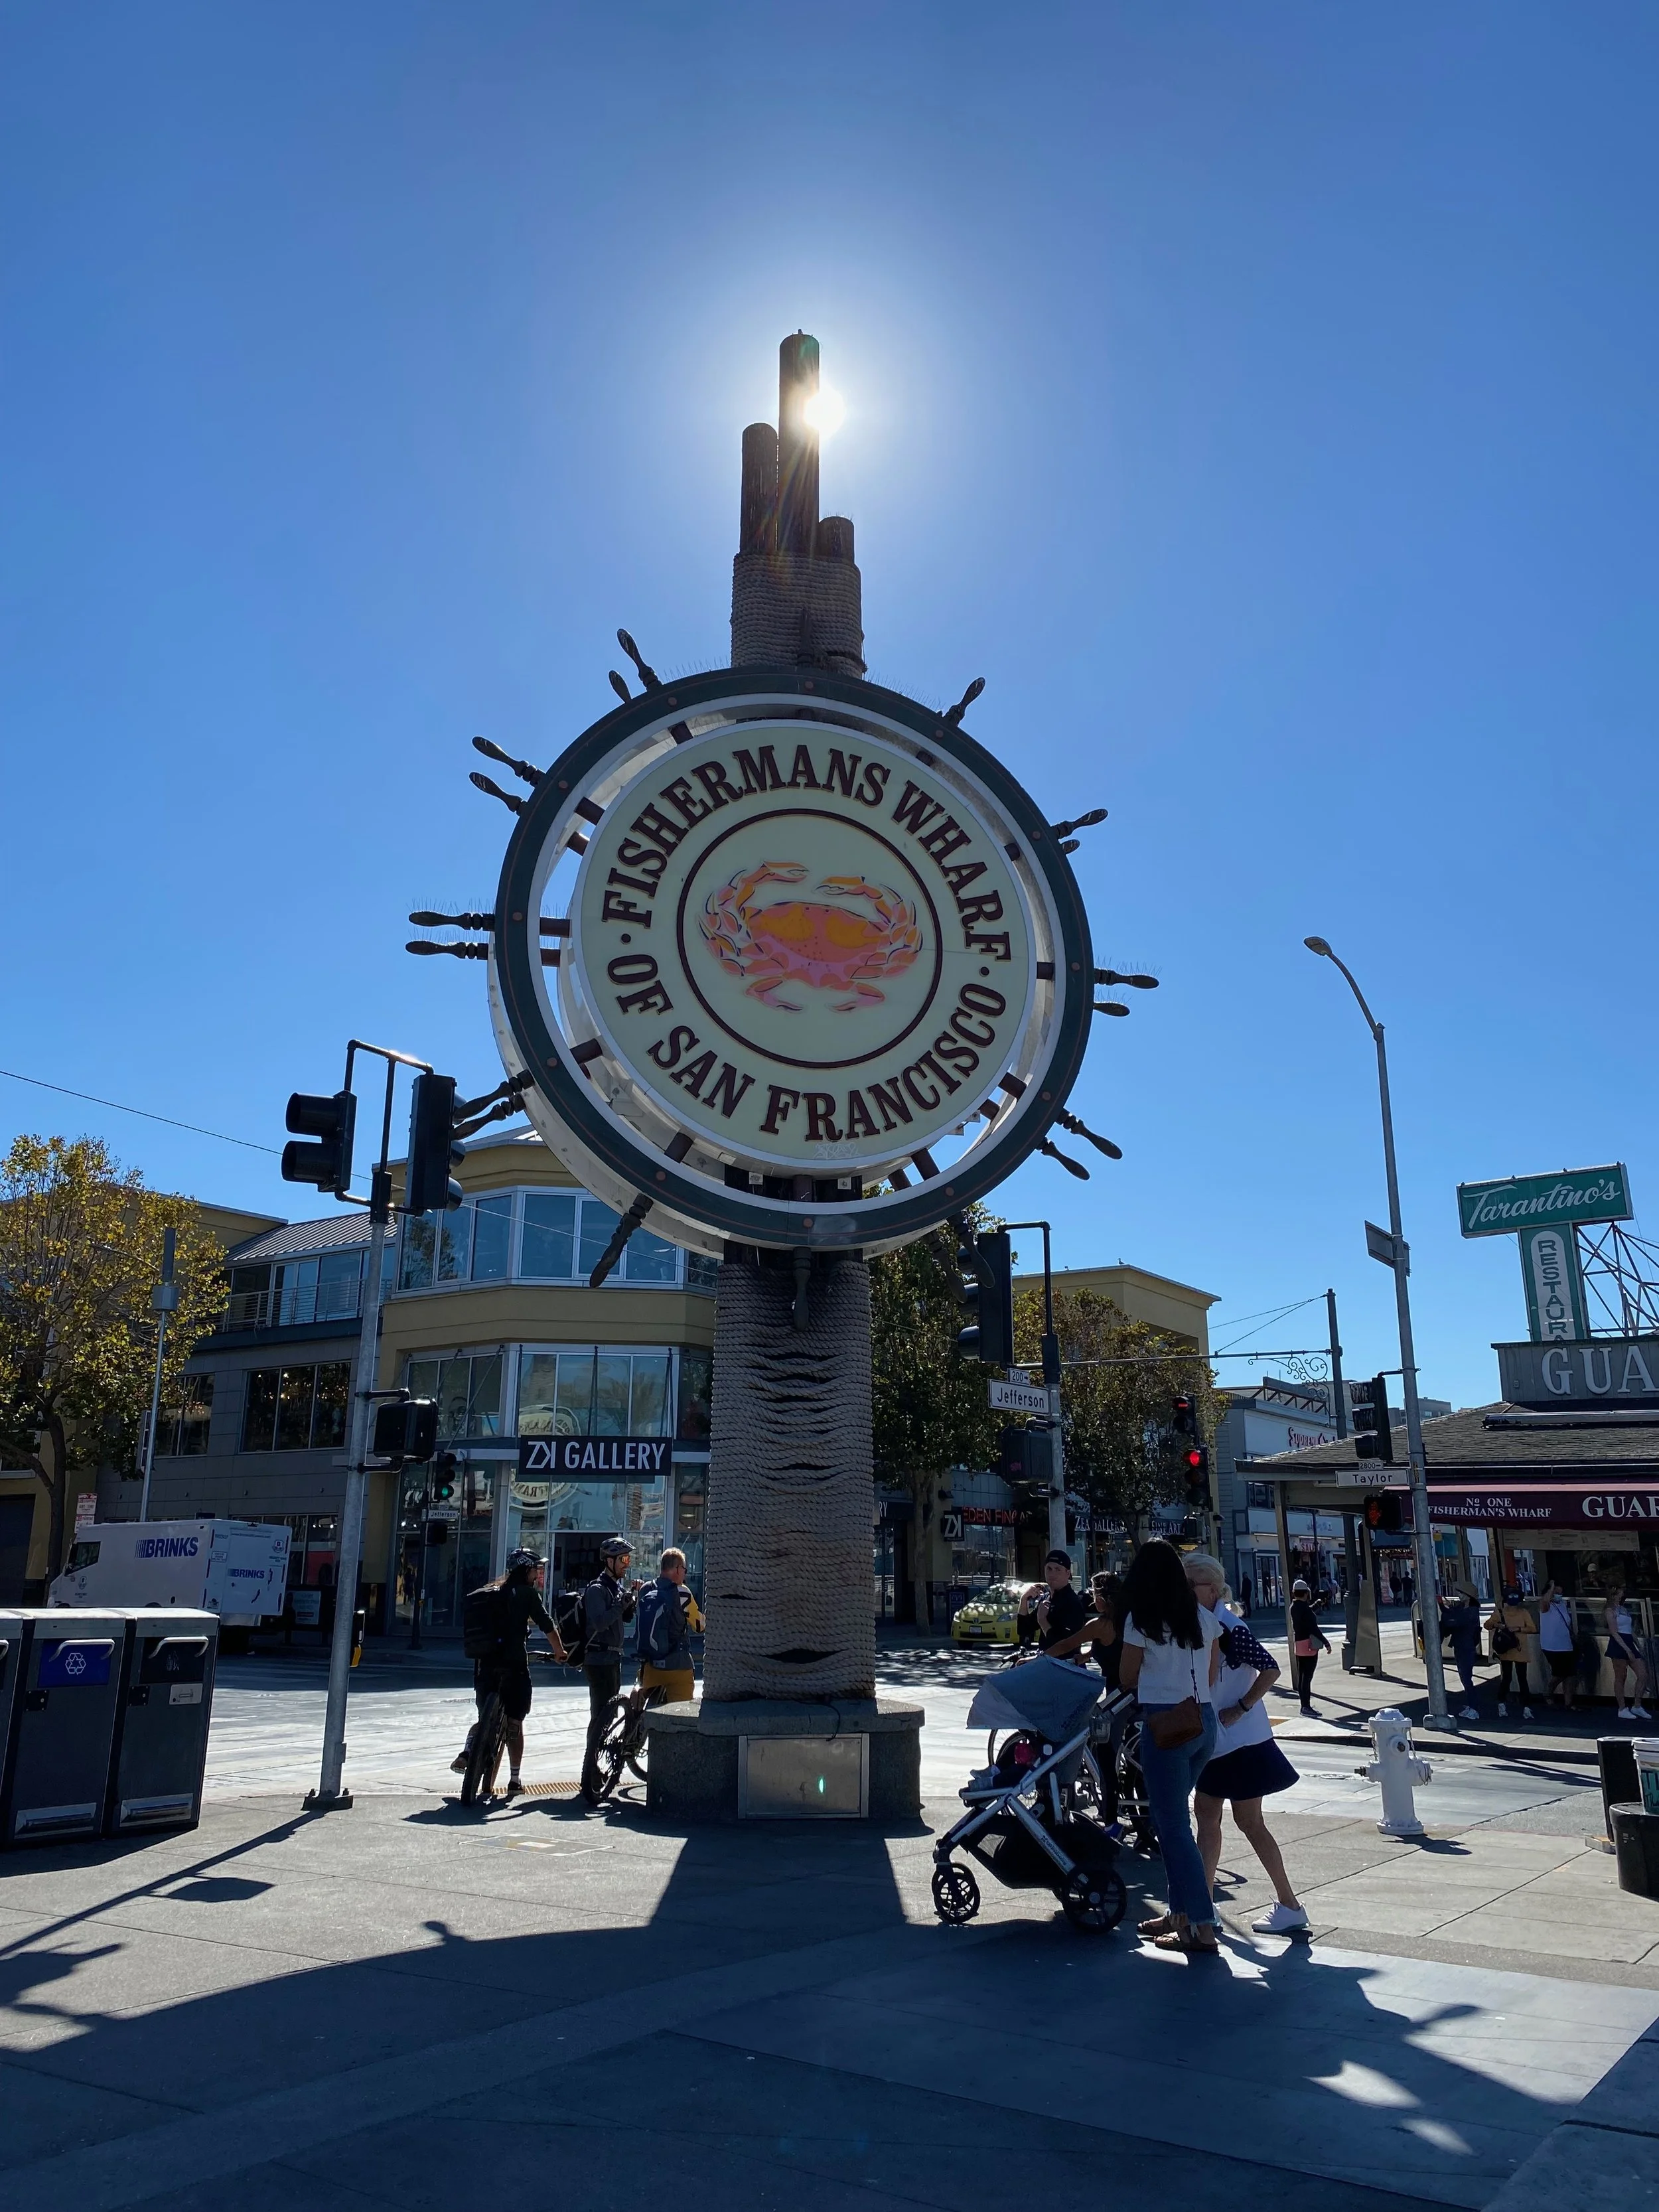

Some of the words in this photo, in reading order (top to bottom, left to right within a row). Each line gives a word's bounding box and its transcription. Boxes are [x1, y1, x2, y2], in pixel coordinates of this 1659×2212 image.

[602, 744, 891, 929] FISHERMANS
[891, 780, 1012, 962] WHARF
[607, 954, 674, 1015] OF
[647, 1025, 757, 1119] SAN
[759, 984, 1007, 1142] FRANCISCO
[1463, 1179, 1621, 1230] Tarantino's
[1012, 1370, 1023, 1382] 200
[997, 1387, 1045, 1408] Jefferson
[565, 1441, 666, 1470] GALLERY
[1352, 1473, 1393, 1485] Taylor
[1486, 1497, 1512, 1507] ONE
[962, 1506, 991, 1524] EDEN
[1428, 1506, 1506, 1517] FISHERMAN'S
[1508, 1507, 1552, 1518] WHARF
[1168, 1522, 1181, 1534] ART
[145, 1537, 199, 1558] BRINKS
[234, 1569, 265, 1578] BRINKS
